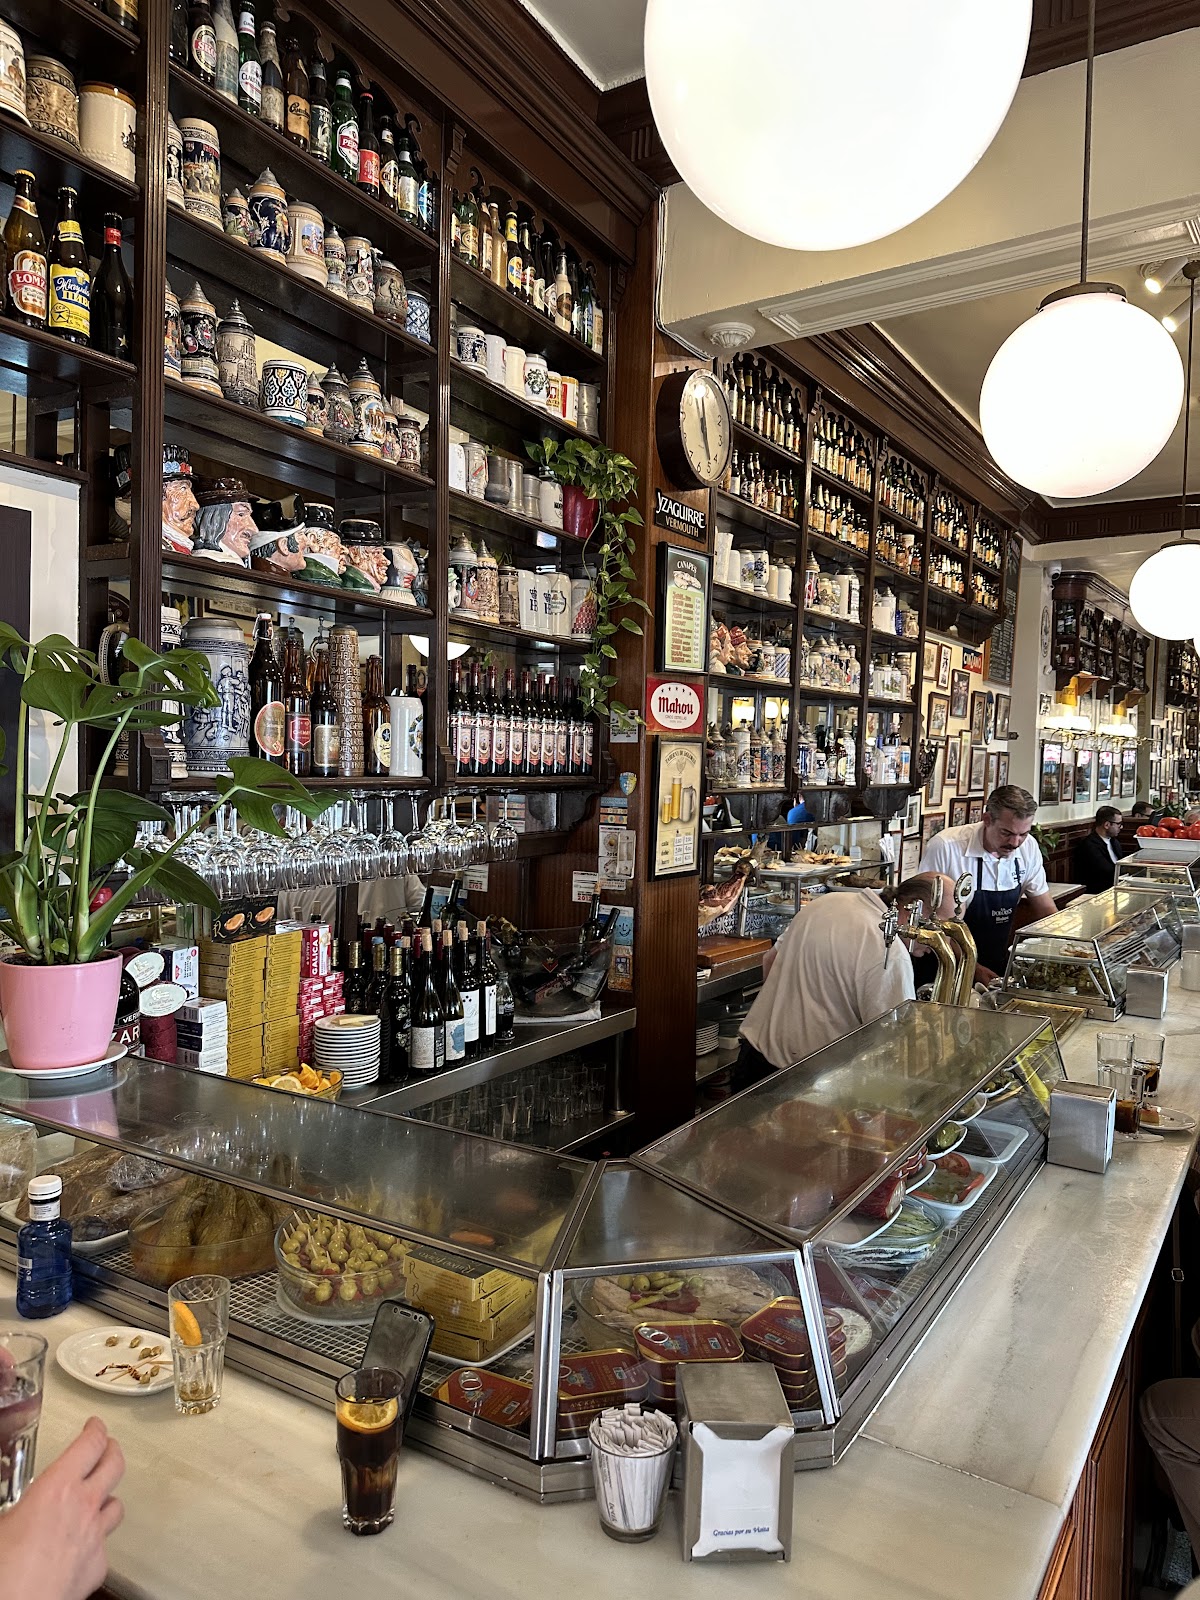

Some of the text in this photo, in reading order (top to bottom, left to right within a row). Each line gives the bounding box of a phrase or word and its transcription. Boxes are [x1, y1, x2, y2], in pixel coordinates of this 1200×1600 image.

[63, 290, 90, 307] ПИВ
[656, 492, 706, 528] YZAGUIRRE
[665, 515, 699, 537] VERMOUTH
[658, 696, 693, 715] Mahou
[123, 1012, 140, 1023] VERM
